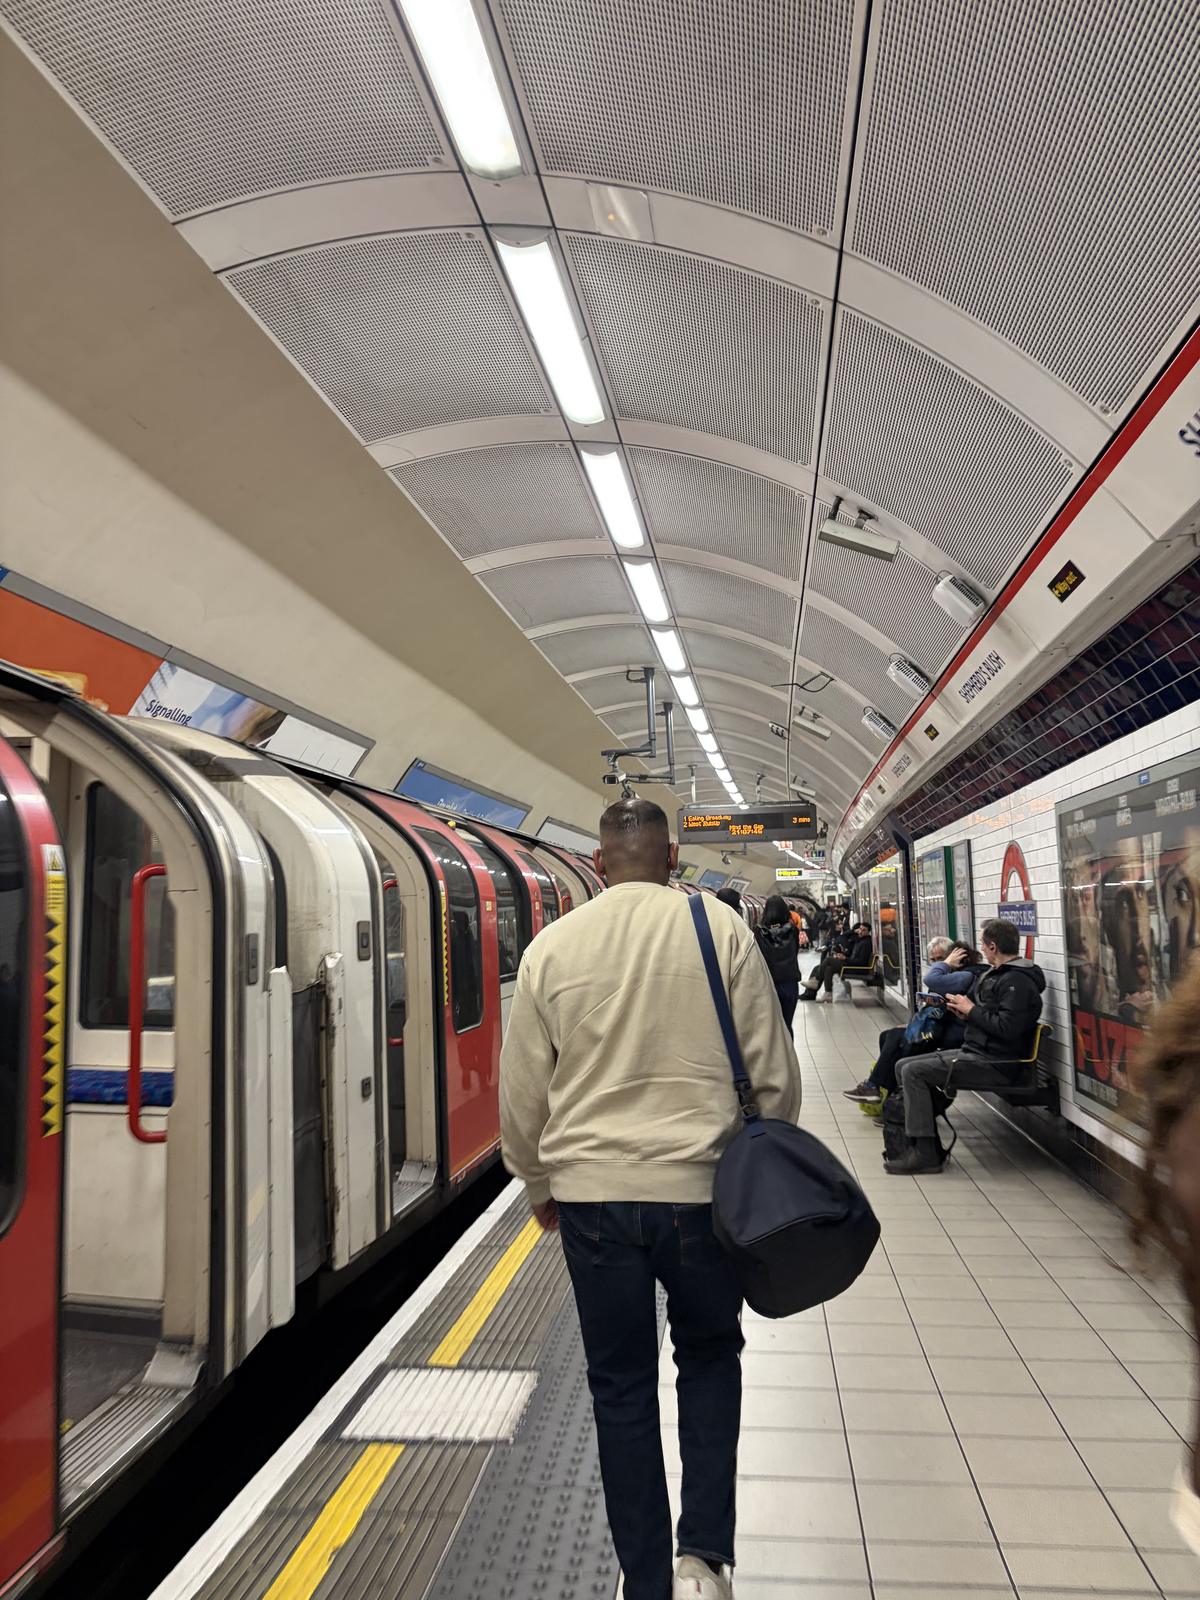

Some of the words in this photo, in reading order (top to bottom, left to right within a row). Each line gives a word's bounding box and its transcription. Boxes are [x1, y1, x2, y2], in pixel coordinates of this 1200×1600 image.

[958, 666, 991, 703] SHEPHERD'S
[982, 650, 1006, 677] BUSH
[145, 699, 192, 726] Signalling
